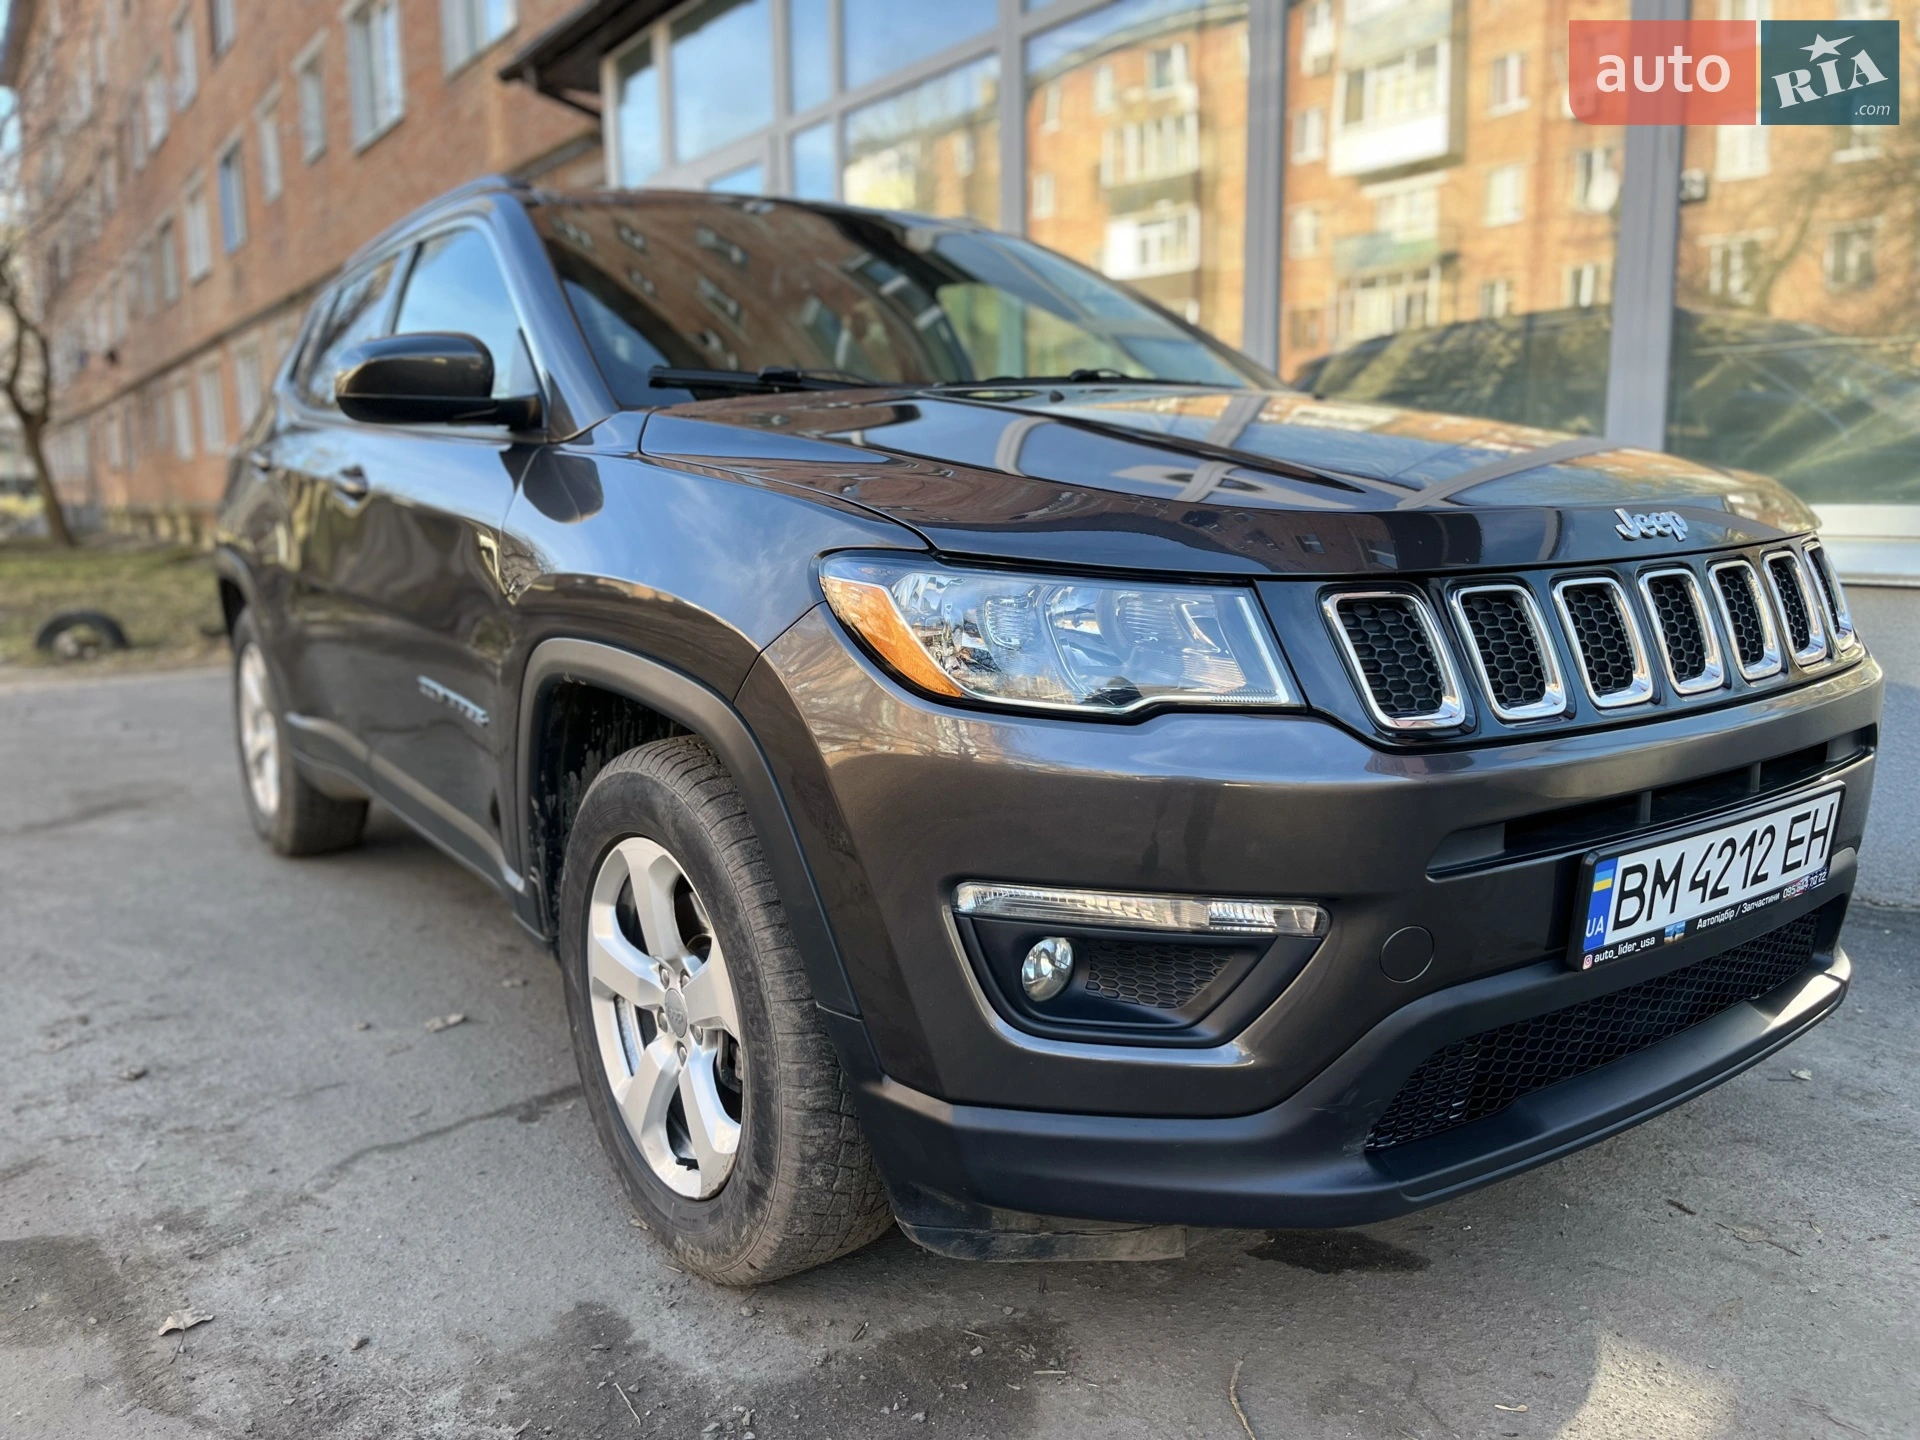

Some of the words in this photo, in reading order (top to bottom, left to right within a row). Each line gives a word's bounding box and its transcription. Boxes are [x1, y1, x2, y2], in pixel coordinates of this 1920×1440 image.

[1614, 508, 1688, 541] Jeep
[1612, 851, 1685, 931] BM
[1688, 824, 1776, 904] 4212
[1781, 802, 1835, 875] EH
[1585, 915, 1604, 937] UA
[1696, 908, 1735, 930] Автопідбір
[1741, 893, 1780, 913] Запчастини
[1594, 937, 1655, 963] auto_lider_usa
